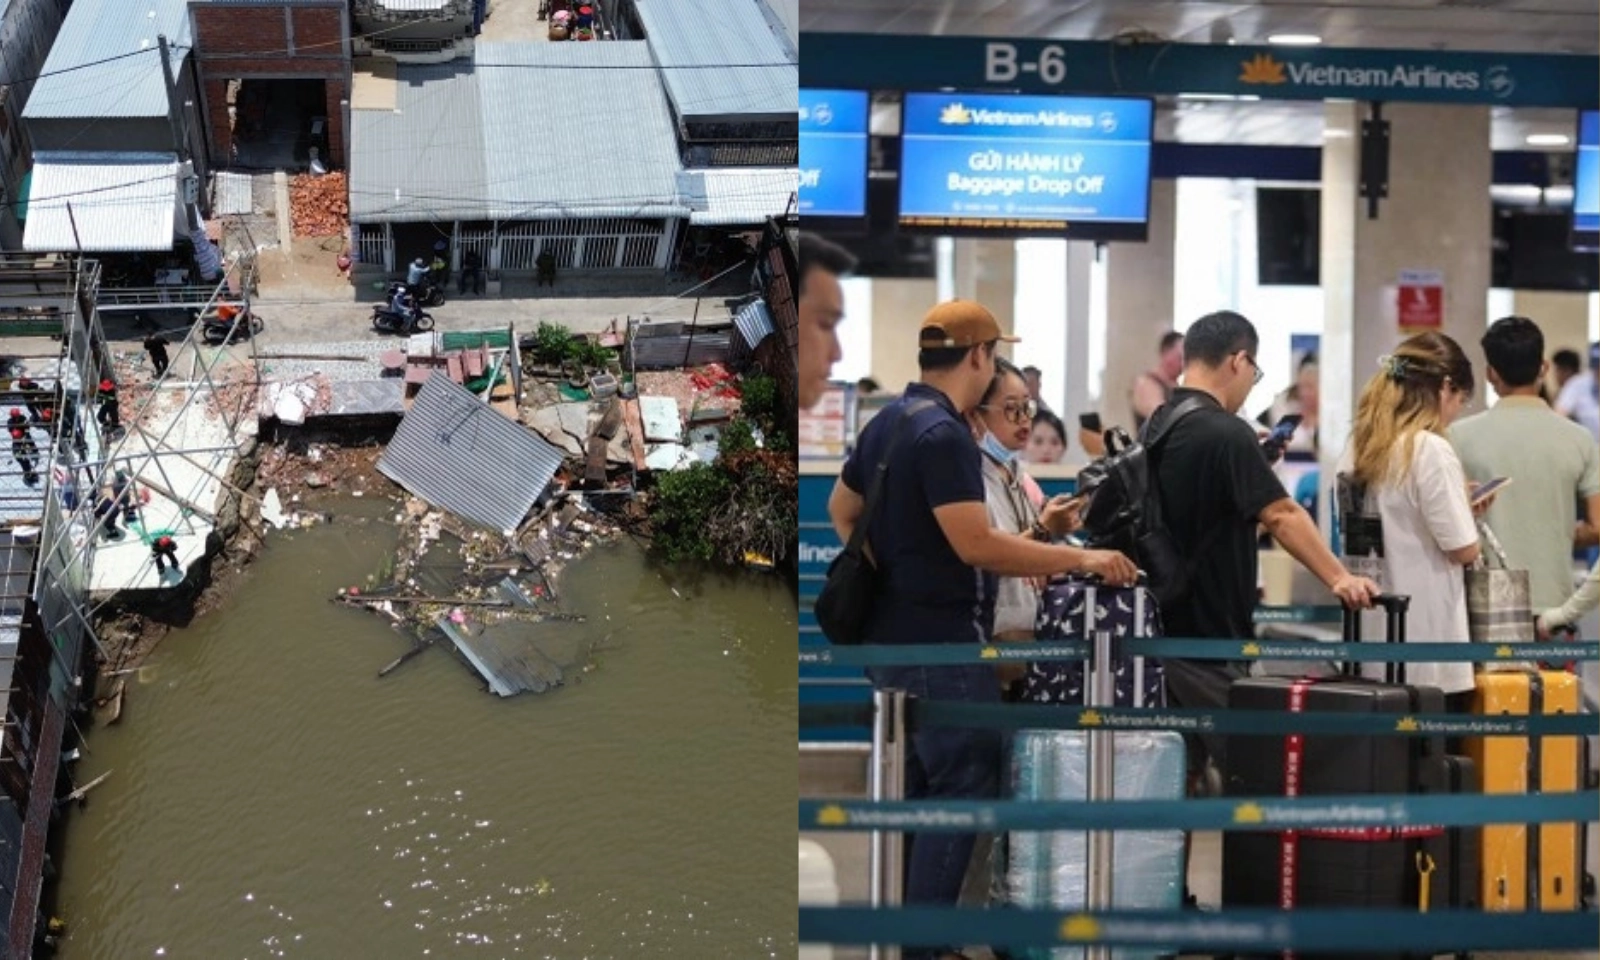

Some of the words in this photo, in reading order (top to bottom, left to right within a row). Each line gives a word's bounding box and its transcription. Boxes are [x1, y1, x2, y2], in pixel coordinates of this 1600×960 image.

[985, 42, 1067, 84] B-6
[947, 173, 1024, 195] Baggage
[1029, 175, 1071, 197] Drop
[1076, 175, 1104, 194] Off
